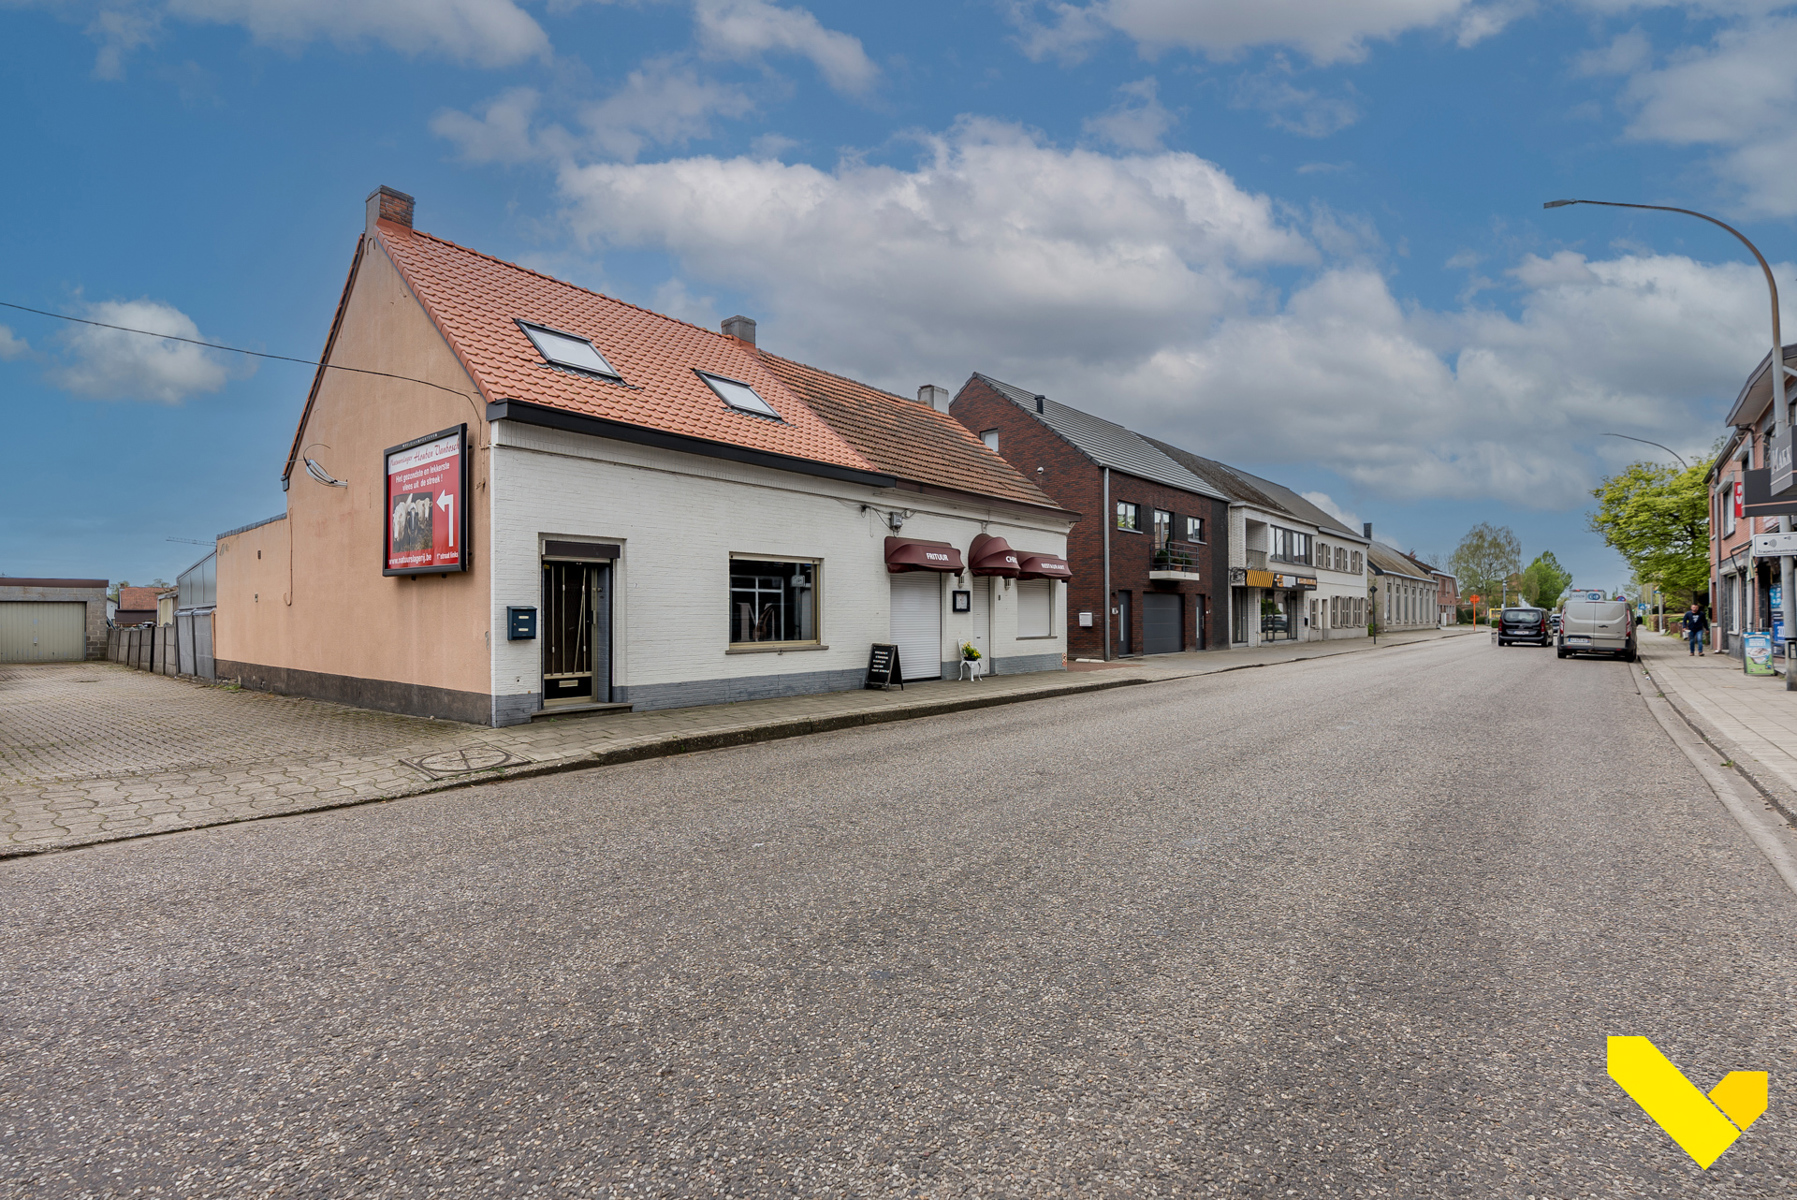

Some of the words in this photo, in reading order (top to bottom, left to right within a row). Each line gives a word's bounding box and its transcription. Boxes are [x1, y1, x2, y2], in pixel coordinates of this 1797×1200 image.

[403, 469, 423, 483] gezondste
[424, 468, 430, 476] en
[430, 462, 450, 473] lekkerste
[420, 478, 426, 487] de
[926, 552, 949, 562] FRITUUR
